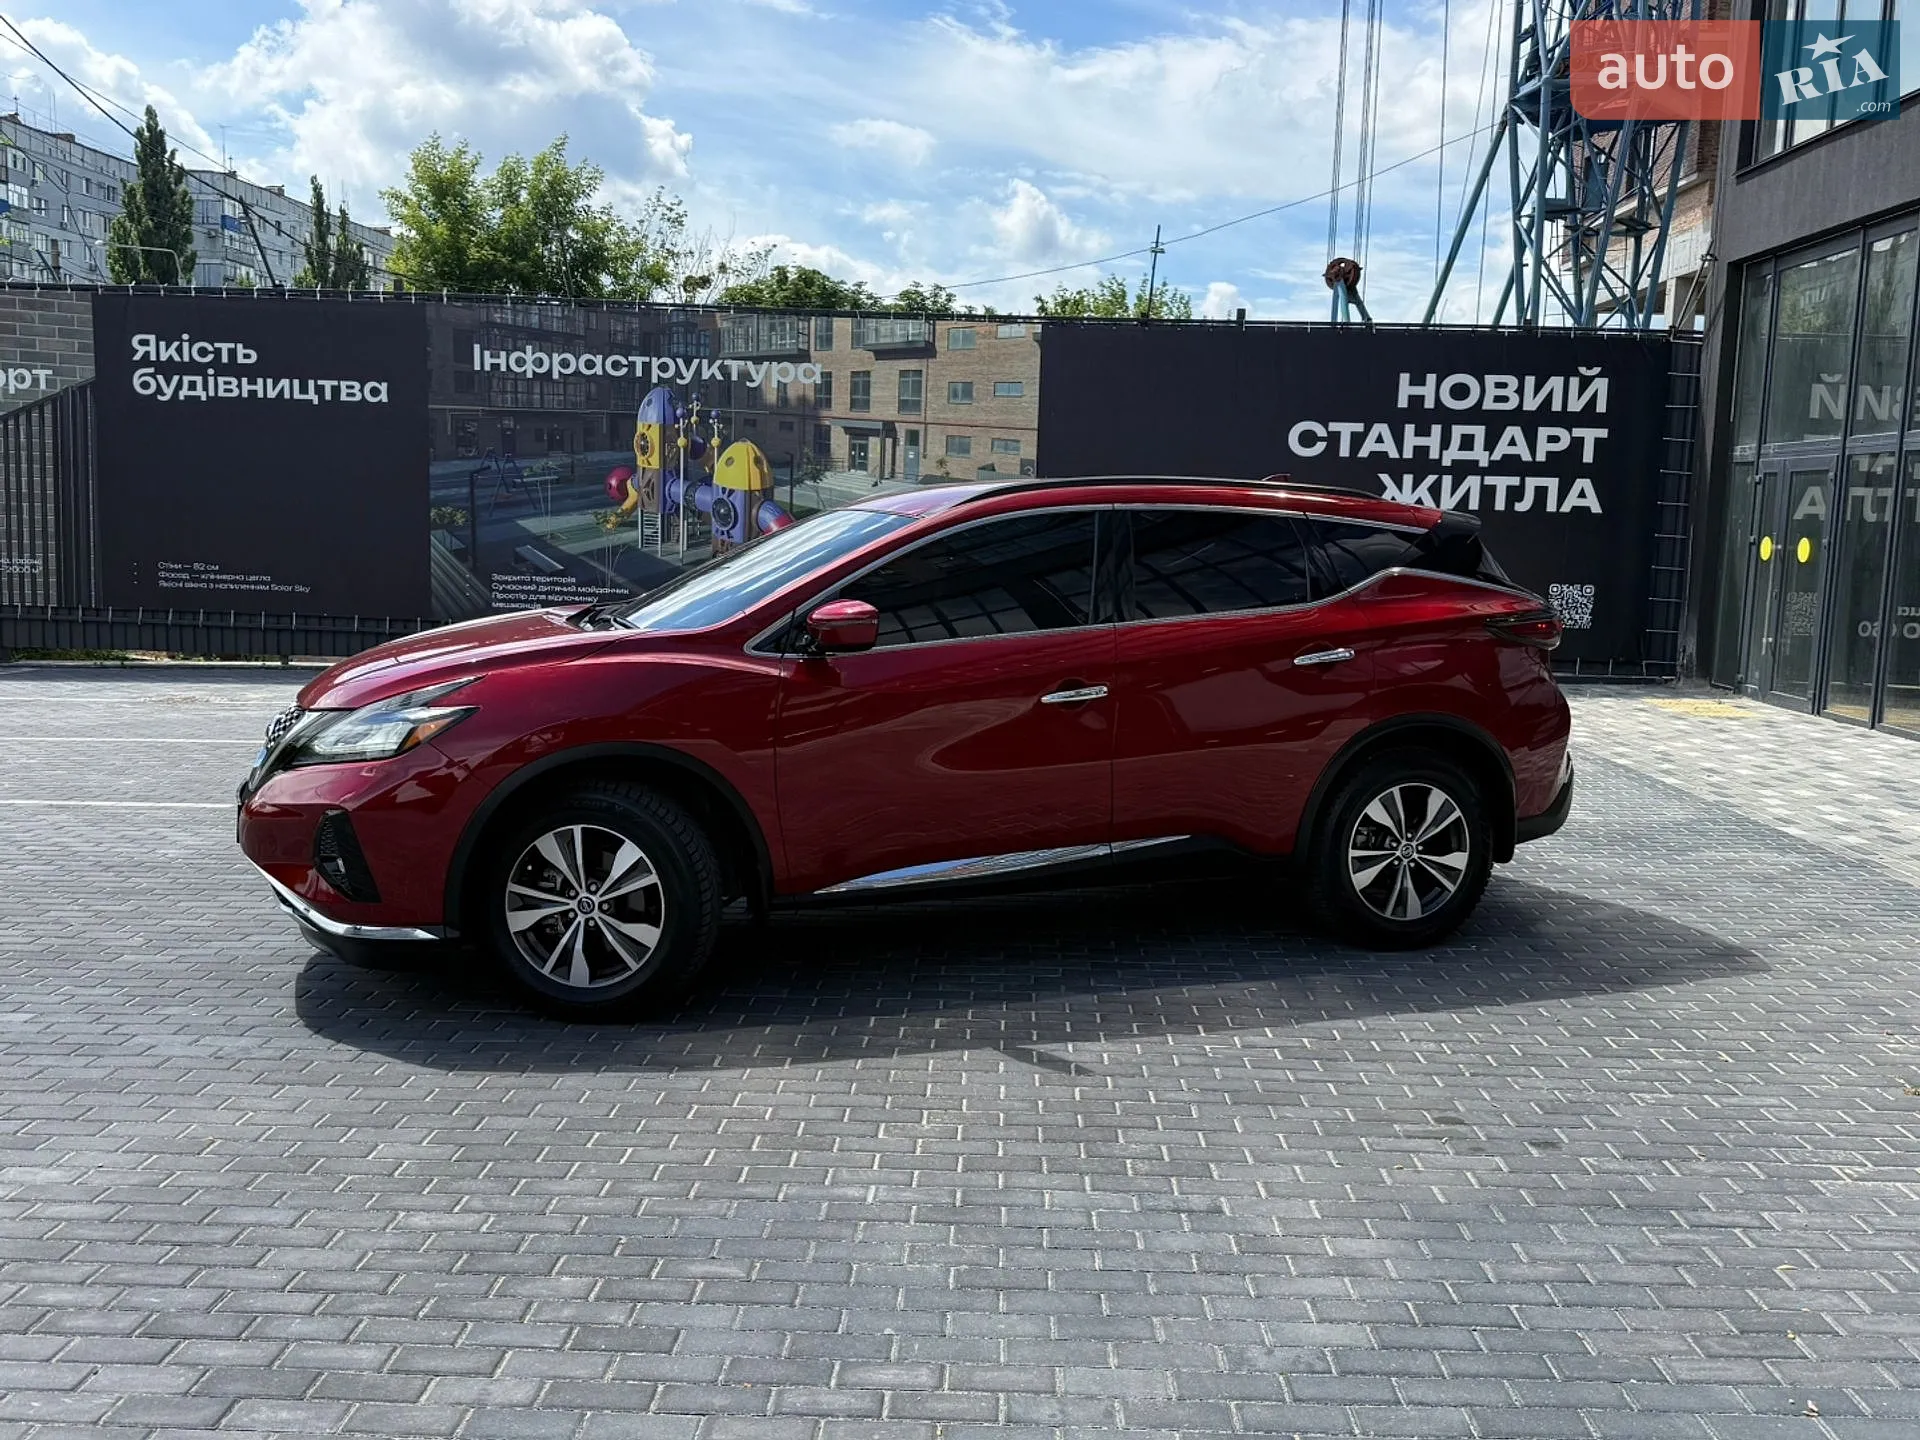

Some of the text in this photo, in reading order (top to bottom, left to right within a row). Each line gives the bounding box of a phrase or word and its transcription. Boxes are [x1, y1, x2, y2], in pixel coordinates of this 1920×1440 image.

[131, 333, 258, 364] Якість
[473, 343, 823, 387] Інфраструктура
[132, 366, 389, 405] будівництва
[1397, 366, 1610, 414] НОВИЙ
[1287, 420, 1608, 467] СТАНДАРТ
[1377, 472, 1602, 514] ЖИТЛА
[491, 592, 529, 601] Простір
[548, 595, 599, 603] відпочинку
[578, 585, 629, 595] майданчик
